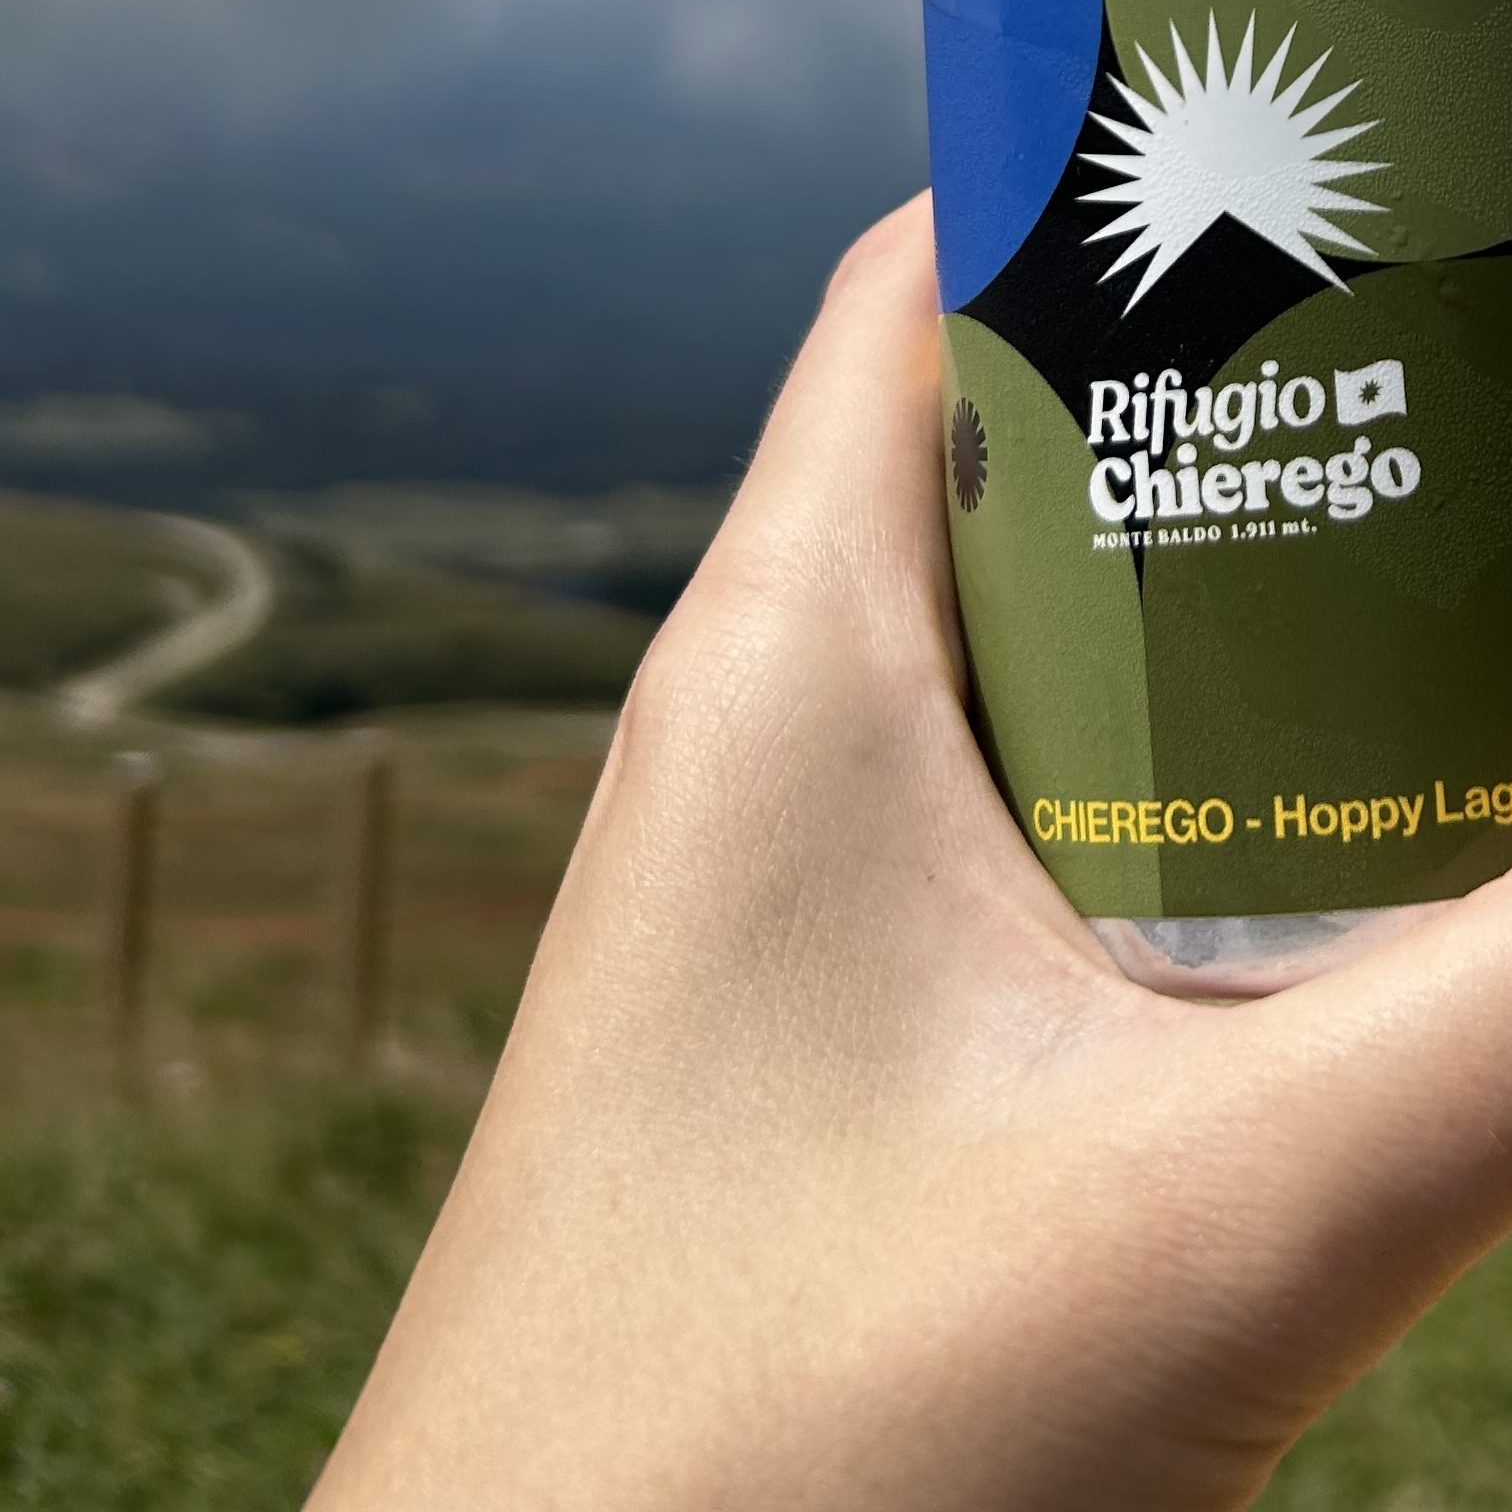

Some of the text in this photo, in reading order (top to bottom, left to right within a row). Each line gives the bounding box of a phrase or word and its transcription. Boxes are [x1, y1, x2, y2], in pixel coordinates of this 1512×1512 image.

[1087, 359, 1326, 455] Rifugio
[1089, 435, 1421, 522] Chierego
[1093, 529, 1153, 549] MONTE
[1158, 524, 1222, 545] BALDO
[1231, 522, 1277, 540] 1.911
[1033, 797, 1234, 843] CHIEREGO
[1273, 793, 1425, 842] Hoppy
